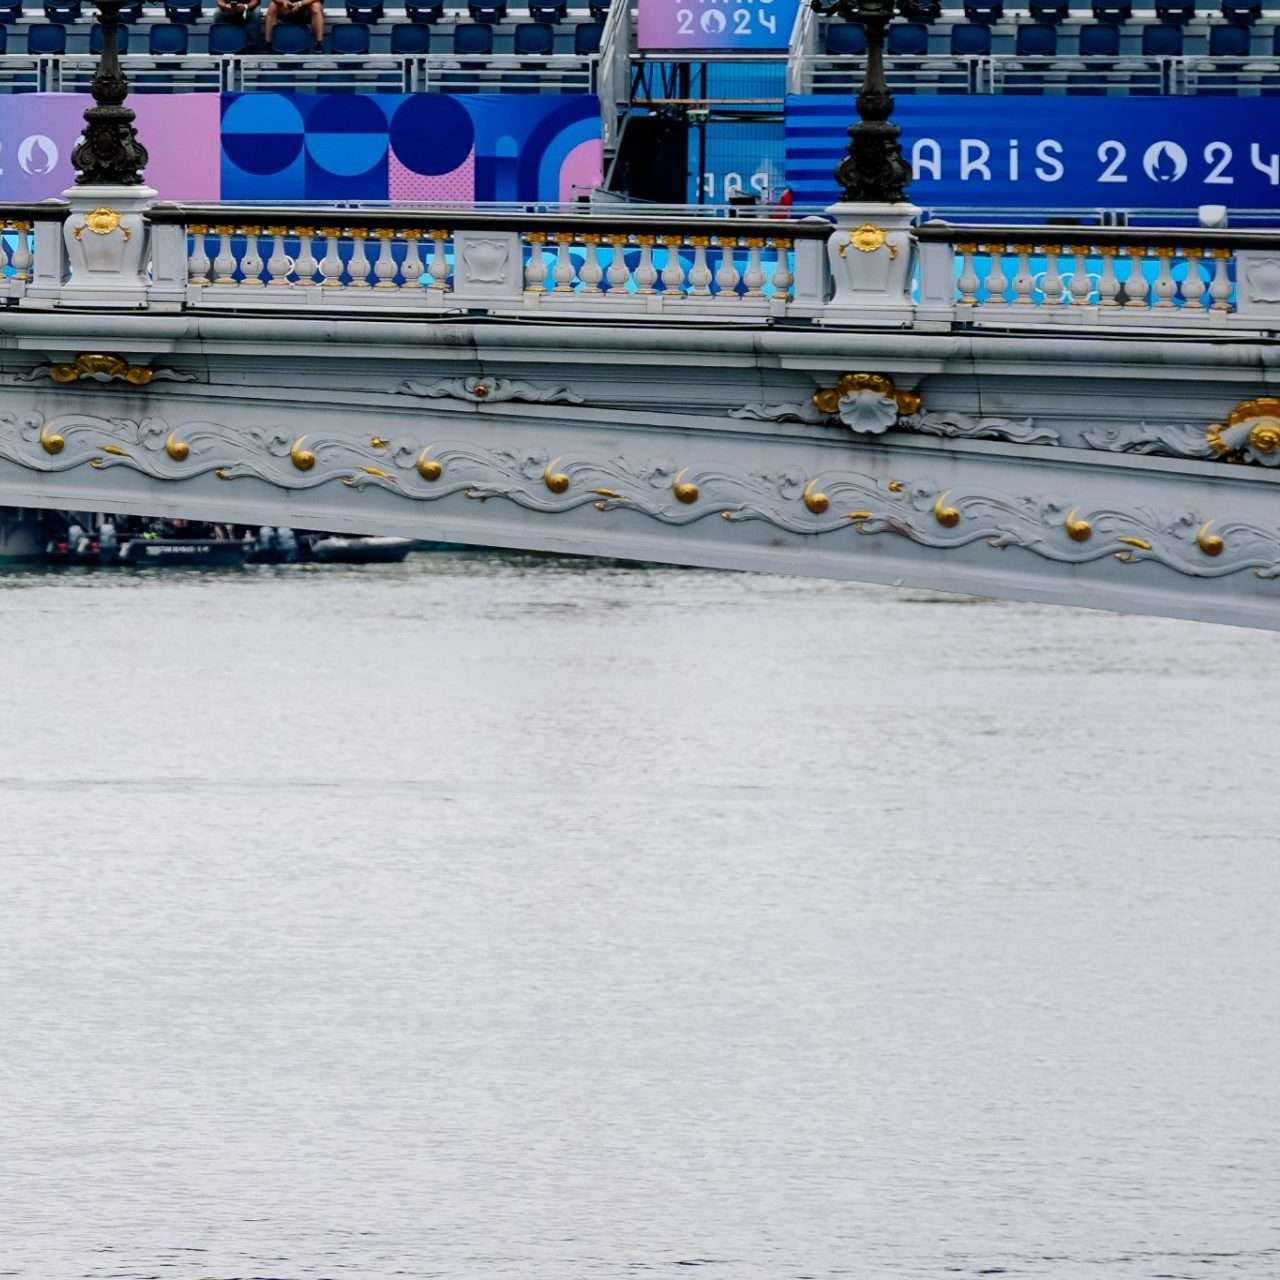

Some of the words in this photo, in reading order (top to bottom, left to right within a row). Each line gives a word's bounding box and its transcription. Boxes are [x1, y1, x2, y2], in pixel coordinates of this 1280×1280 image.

[675, 8, 777, 35] 2024
[912, 138, 1065, 182] ARiS
[1096, 138, 1280, 186] 2024
